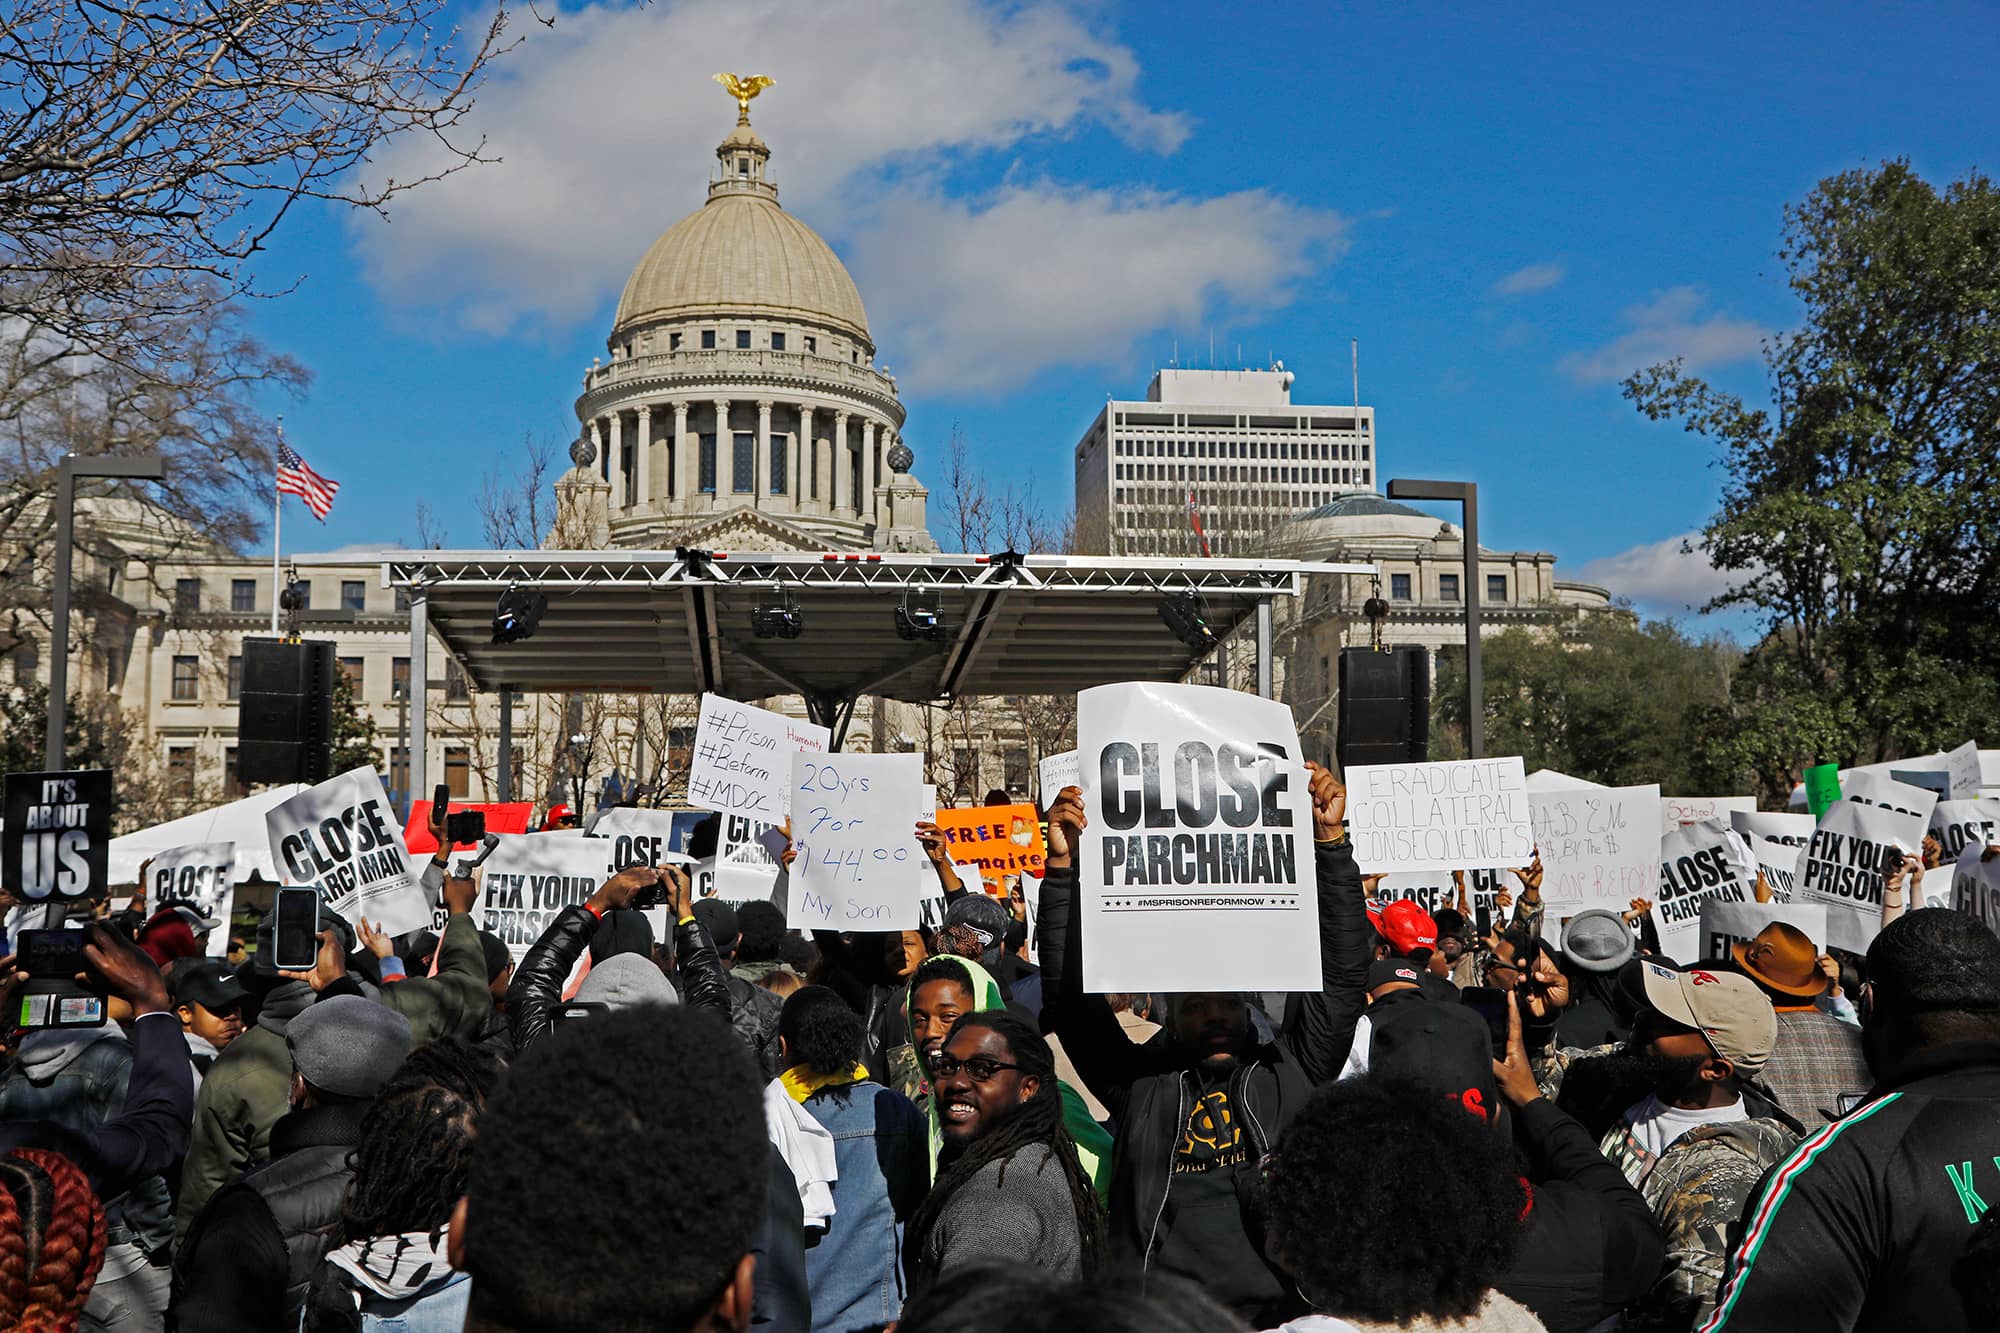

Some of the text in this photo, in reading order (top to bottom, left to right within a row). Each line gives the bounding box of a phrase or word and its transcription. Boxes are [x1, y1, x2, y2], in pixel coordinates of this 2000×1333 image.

[707, 710, 777, 750] #Prison
[787, 725, 822, 751] Humanity
[42, 778, 76, 803] IT'S
[692, 775, 770, 811] #MDOC
[800, 764, 870, 804] 20yrs
[1100, 741, 1293, 830] CLOSE
[1368, 762, 1520, 797] ERADICATE
[26, 803, 90, 830] ABOUT
[810, 807, 864, 833] For
[1354, 794, 1529, 829] COLLATERAL
[1667, 800, 1716, 820] School
[281, 799, 394, 883] CLOSE
[944, 824, 1007, 844] FREE
[1356, 825, 1530, 862] CONSEQUENCES
[1809, 830, 1844, 863] FIX
[1849, 836, 1888, 874] YOU
[21, 830, 90, 898] US
[314, 847, 405, 904] ARCHMAN
[1102, 833, 1297, 885] PARCHMAN
[1659, 845, 1736, 901] CLOSE
[156, 865, 227, 902] CLOSE
[485, 874, 596, 909] FIX YOUR
[1803, 859, 1884, 905] PRISON
[802, 892, 832, 920] My
[846, 899, 892, 919] Son
[1137, 897, 1265, 907] #MSPRISONREFORMNOW
[1945, 1156, 2000, 1224] K
